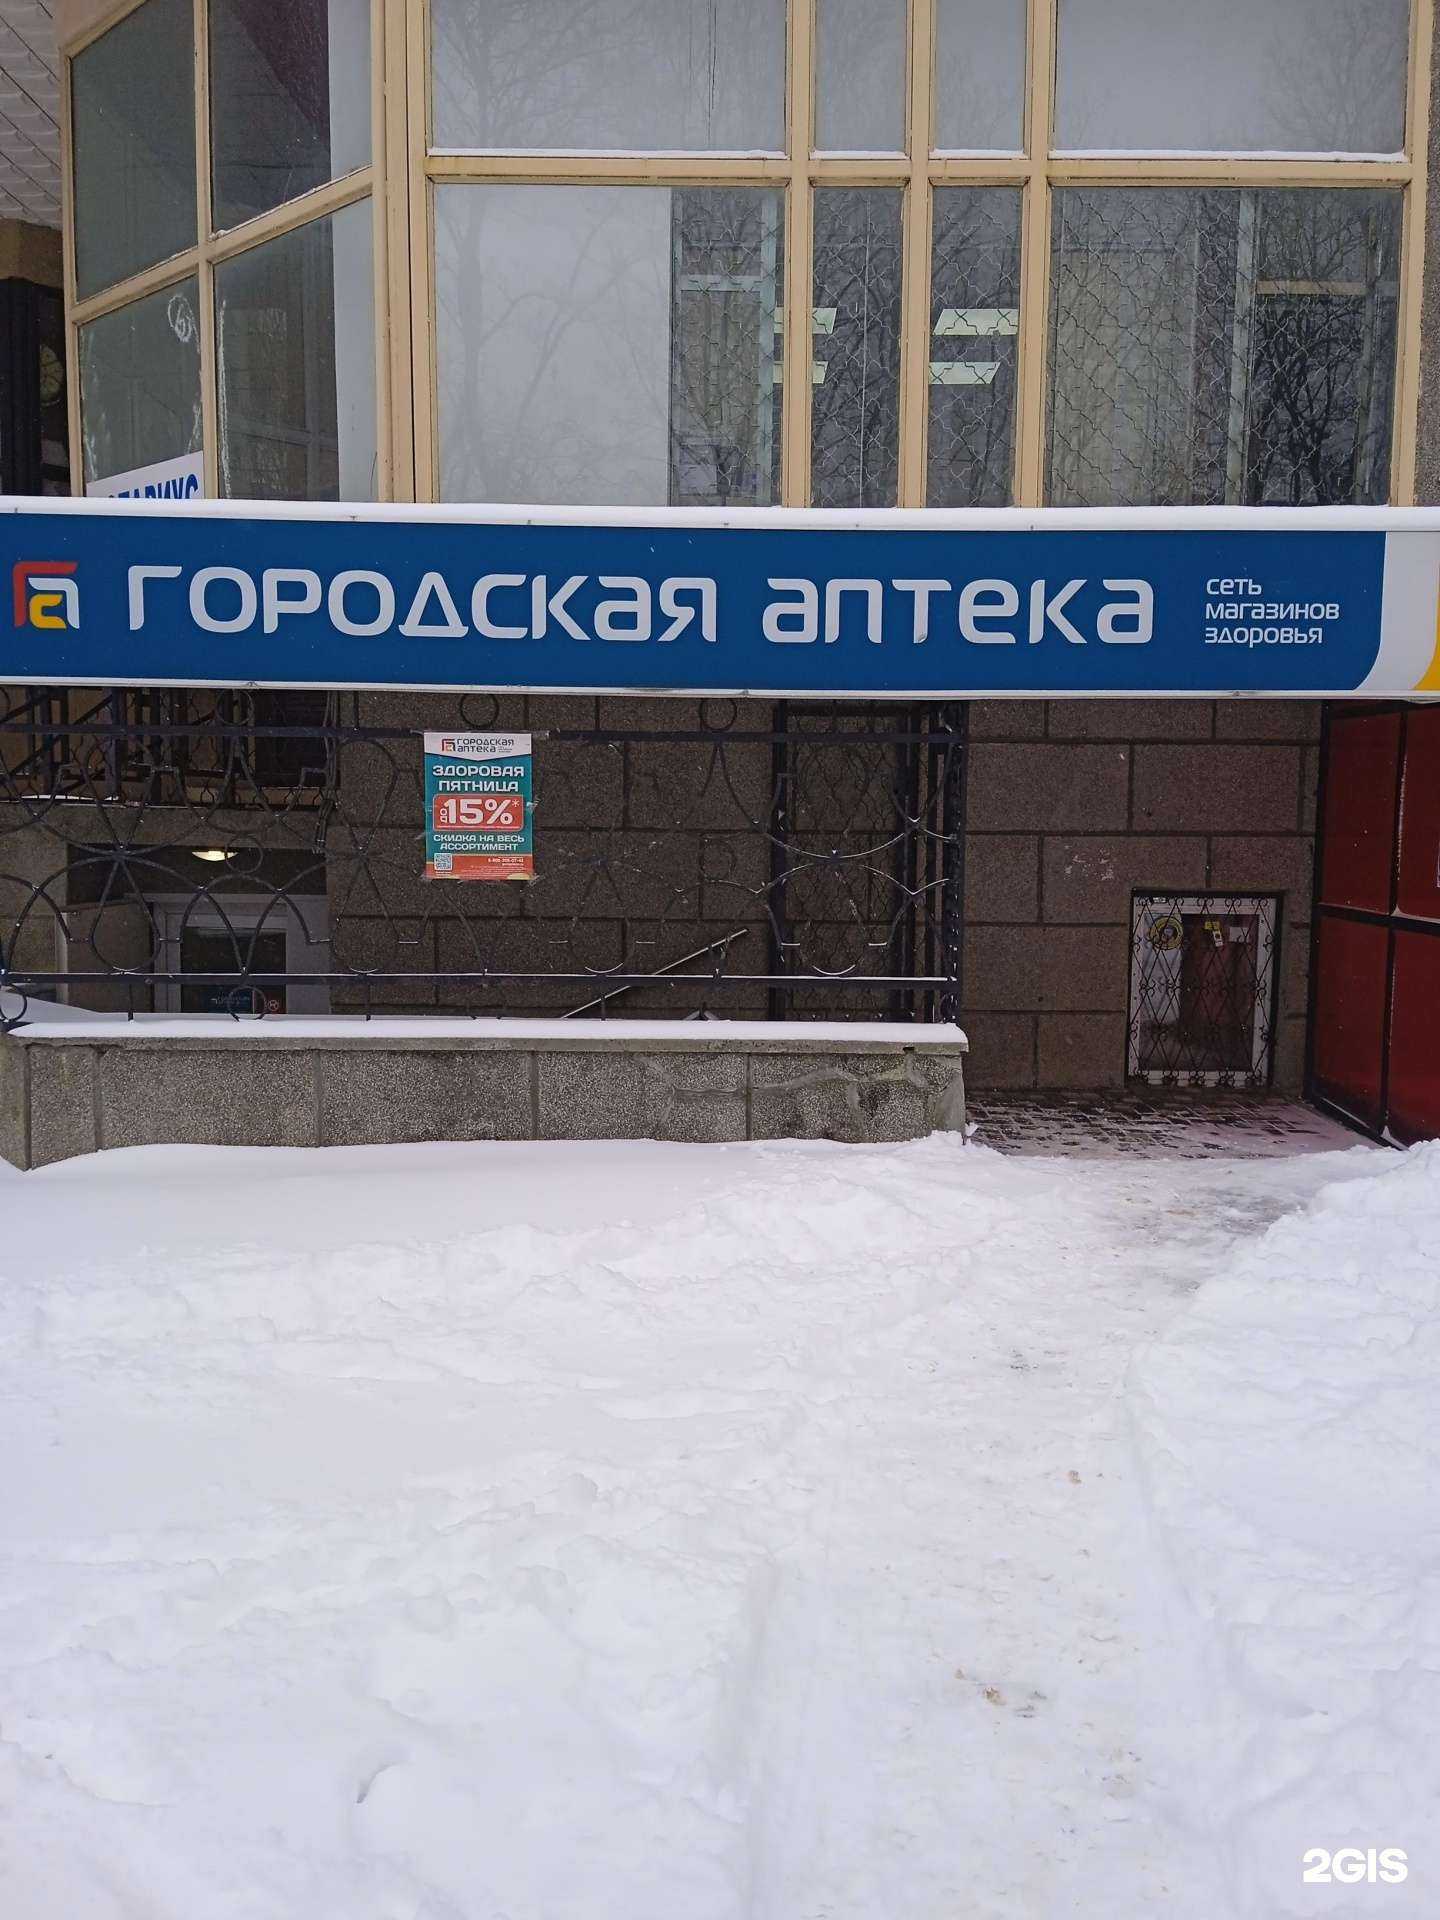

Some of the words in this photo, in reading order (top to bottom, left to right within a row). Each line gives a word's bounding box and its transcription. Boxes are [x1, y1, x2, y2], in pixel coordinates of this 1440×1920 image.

[1207, 579, 1261, 594] сеть
[1206, 604, 1339, 619] магазинов
[1205, 628, 1322, 647] здоровья
[432, 765, 525, 777] ЗДОРОВАЯ
[438, 780, 519, 792] ПЯТНИЦА
[433, 834, 477, 843] СКИДКА
[479, 834, 494, 843] НА
[497, 835, 525, 843] ВЕСЬ
[439, 842, 519, 851] АССОРТИМЕНТ
